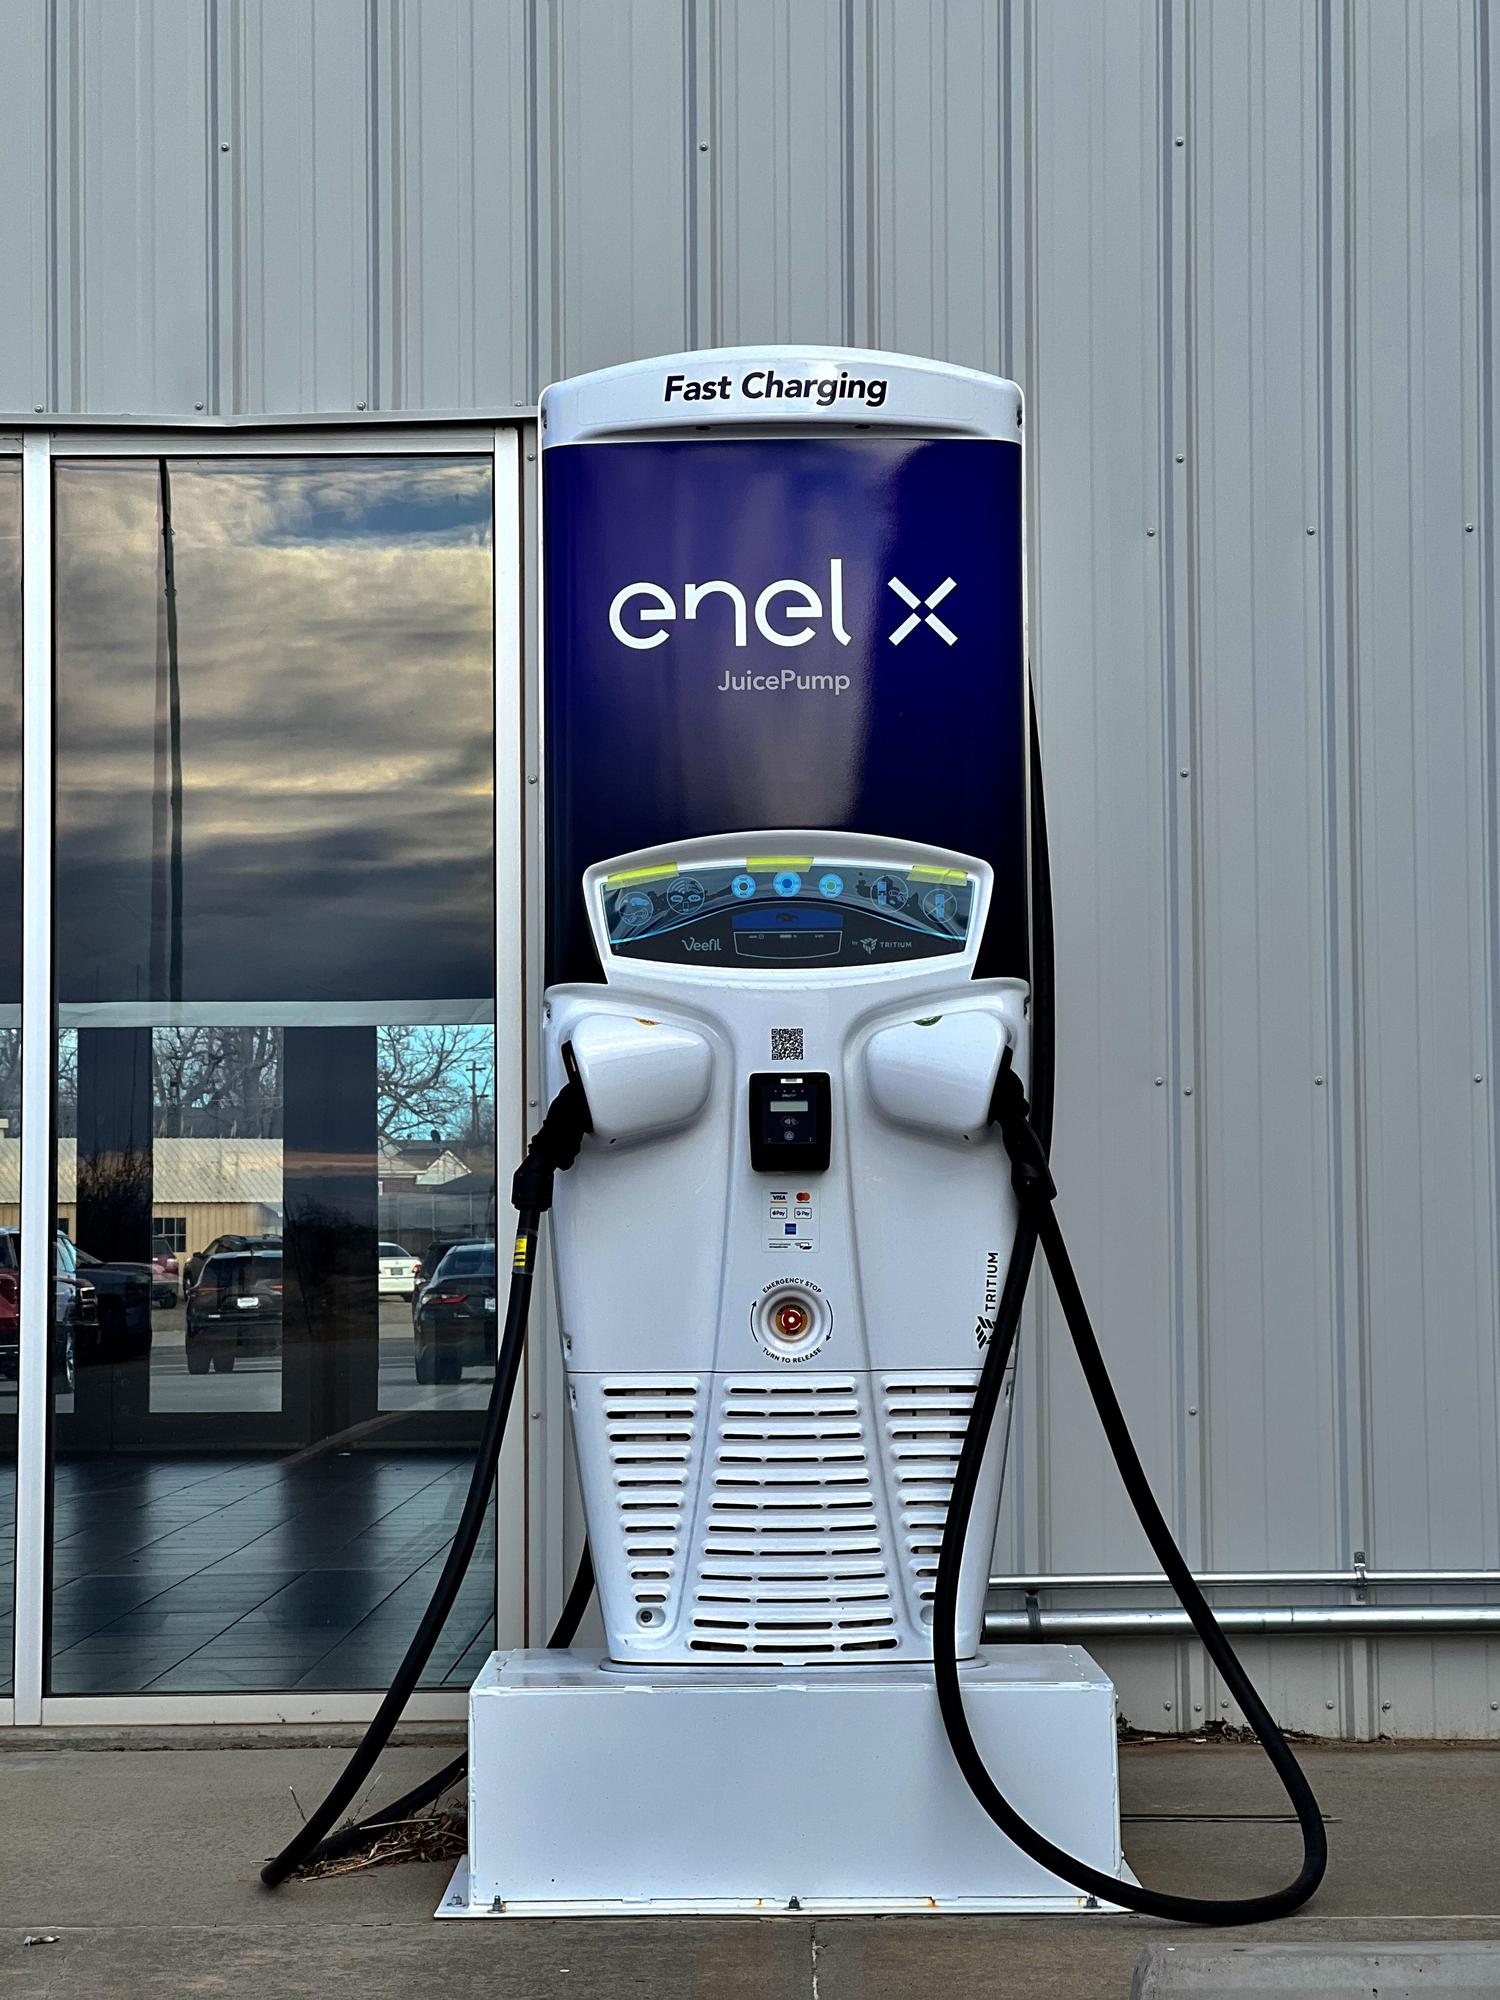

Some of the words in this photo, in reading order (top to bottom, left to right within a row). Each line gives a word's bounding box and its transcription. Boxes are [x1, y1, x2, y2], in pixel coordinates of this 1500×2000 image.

[664, 374, 732, 402] Fast
[741, 371, 888, 406] Charging
[608, 558, 852, 650] enel
[717, 669, 851, 696] JuicePump
[681, 936, 723, 952] Veefil
[879, 941, 912, 949] TRITIUM
[762, 1278, 805, 1294] EMERGENCY
[804, 1280, 822, 1294] STOP
[985, 1252, 999, 1312] TRITIUM
[762, 1347, 780, 1361] TURN
[781, 1356, 791, 1364] TO
[792, 1347, 822, 1363] RELEASE
